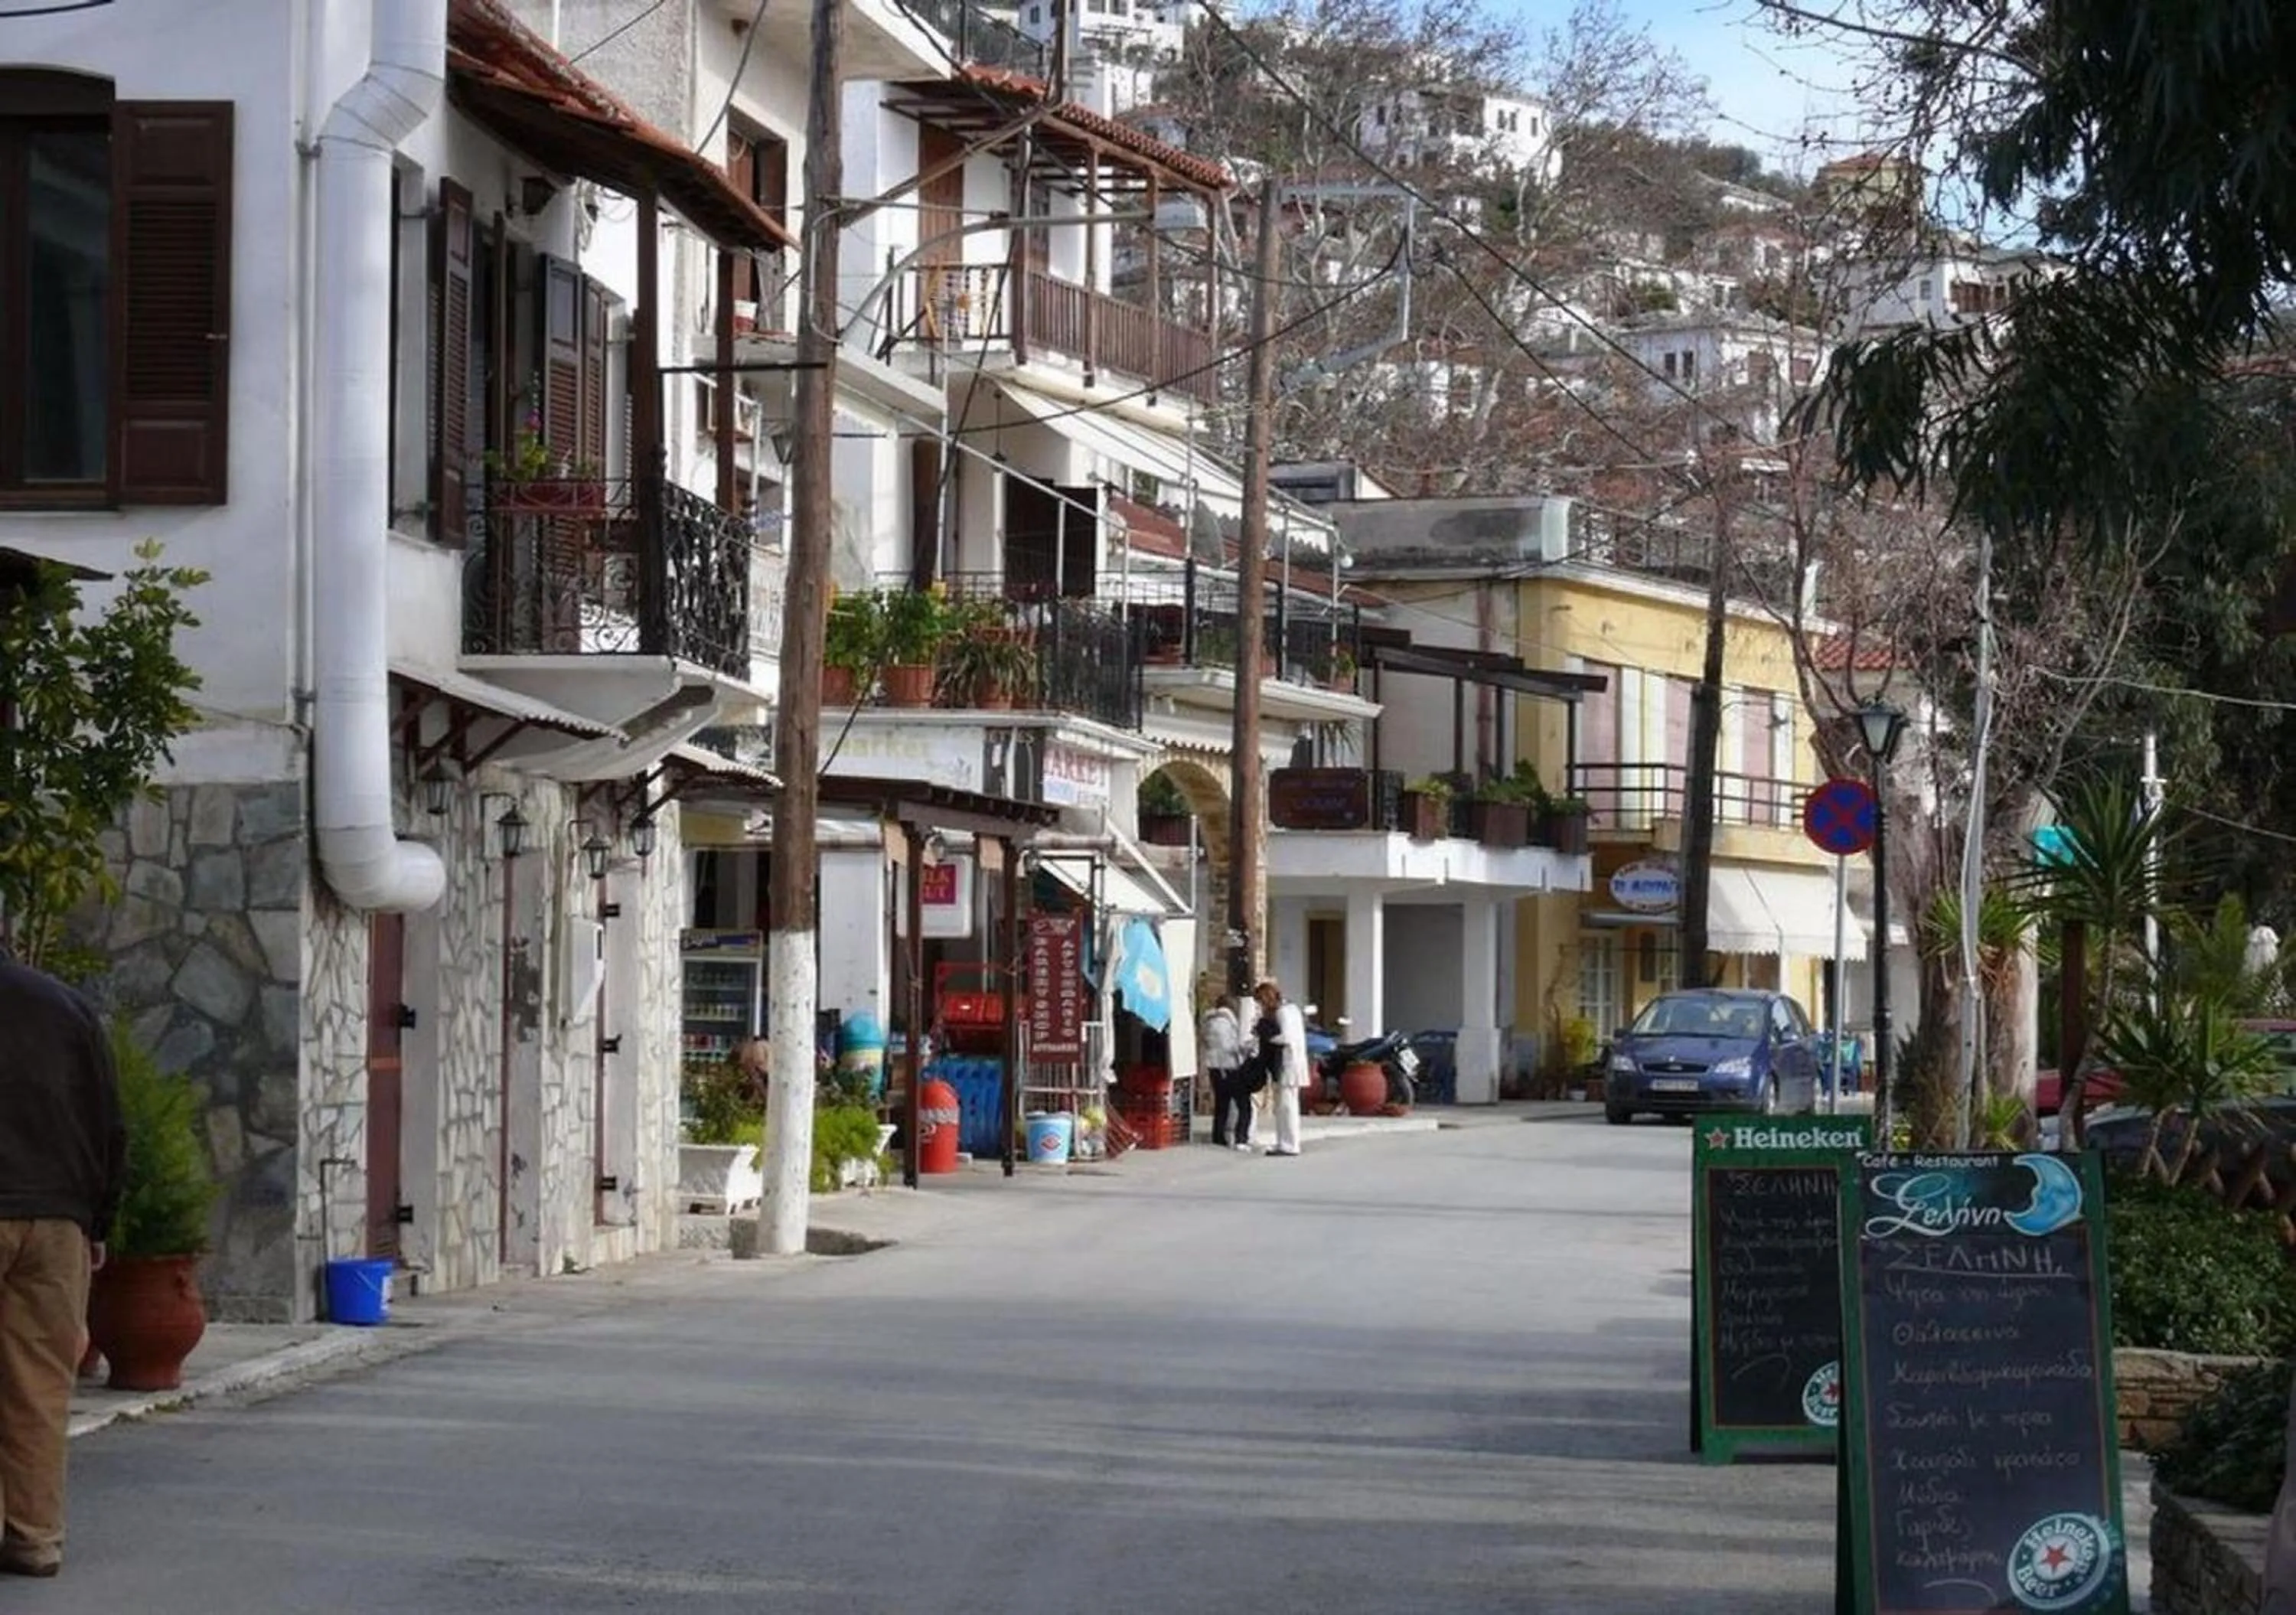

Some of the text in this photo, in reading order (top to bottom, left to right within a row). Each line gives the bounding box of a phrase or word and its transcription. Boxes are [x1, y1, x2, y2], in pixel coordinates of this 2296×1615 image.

[1733, 1127, 1863, 1148] Heineken
[1913, 1154, 1998, 1168] Restaurant
[2016, 1564, 2062, 1598] Beer
